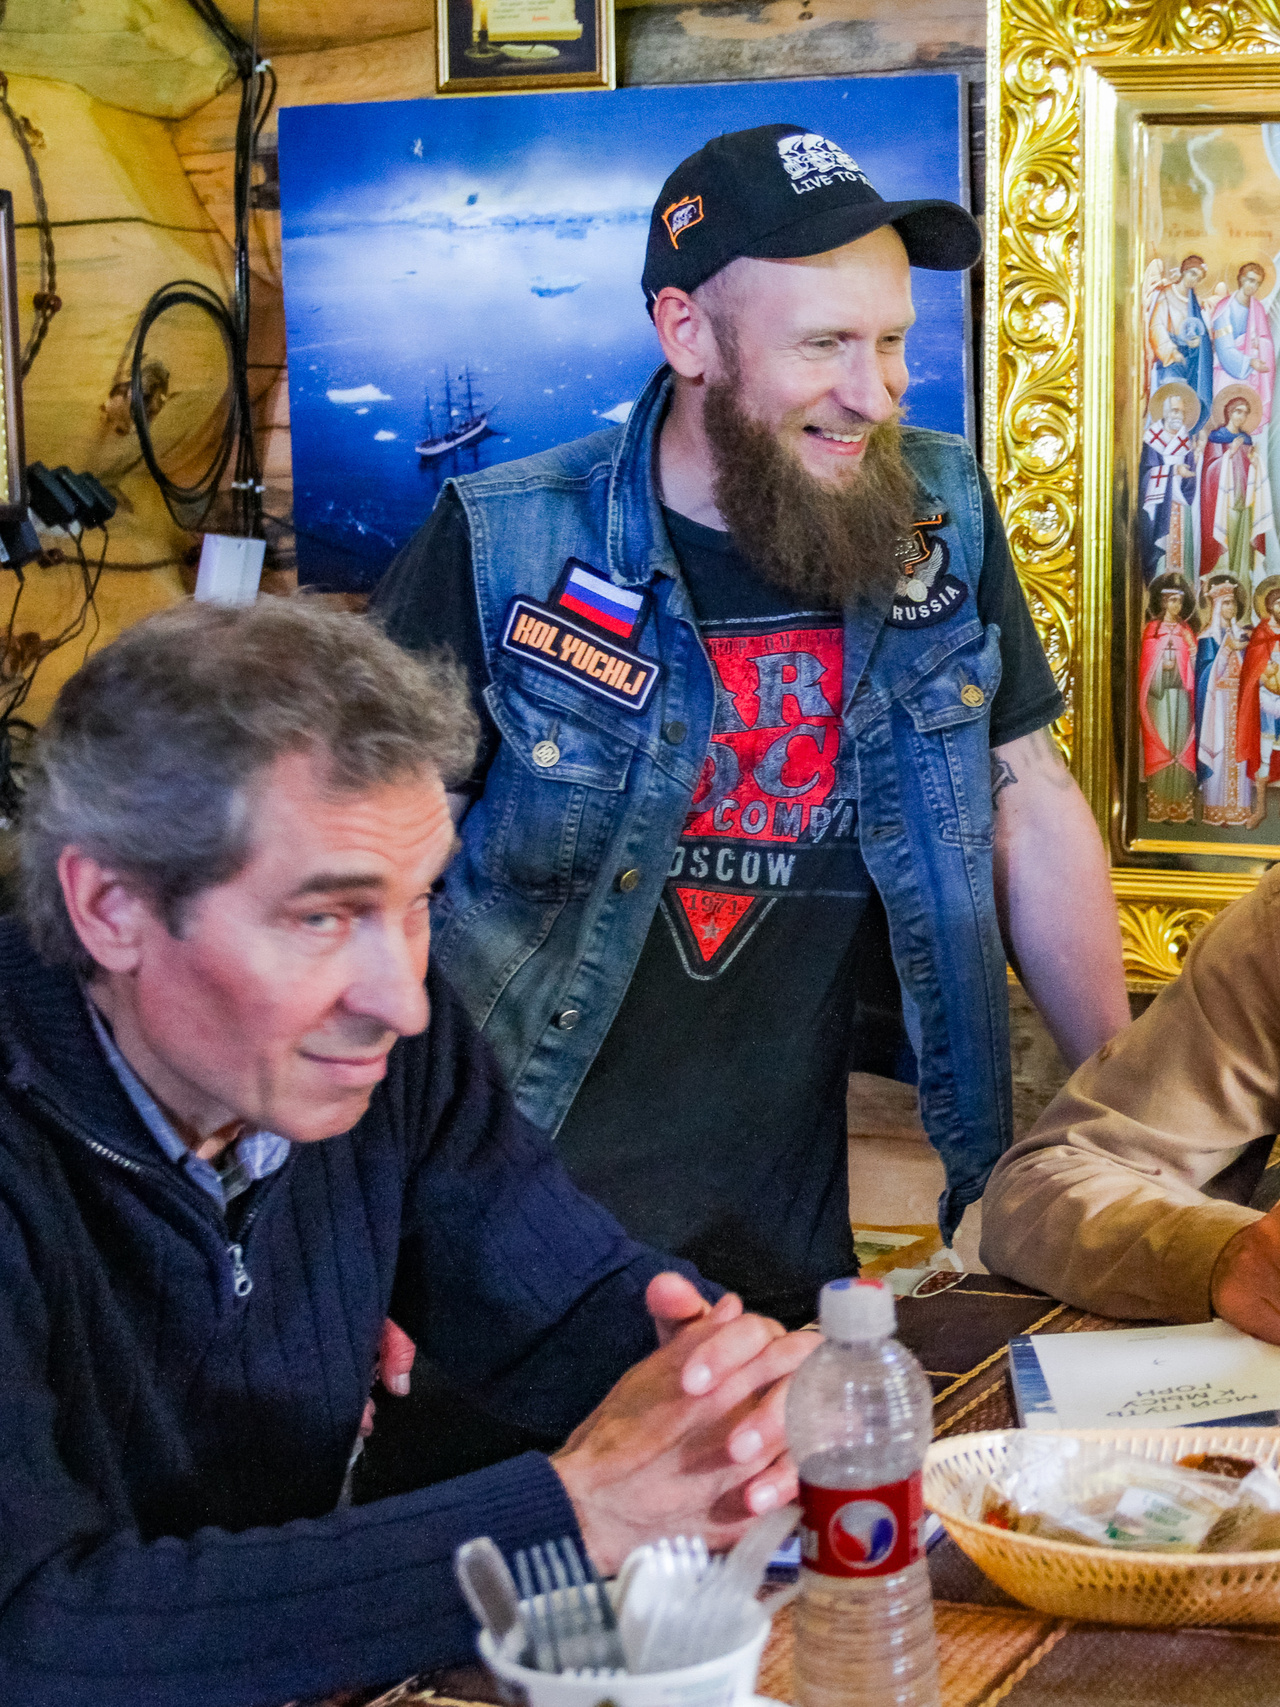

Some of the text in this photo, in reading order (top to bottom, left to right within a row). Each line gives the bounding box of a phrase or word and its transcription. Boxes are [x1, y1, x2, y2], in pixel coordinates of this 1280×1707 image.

[791, 174, 833, 195] LIVE
[833, 171, 858, 183] TO
[893, 585, 960, 621] RUSSIA
[512, 613, 647, 696] KOLYUCHIJ
[711, 631, 843, 656] TOP QUALIT
[713, 798, 859, 844] COMPA
[667, 846, 797, 887] OSCOW
[687, 893, 741, 917] 1971
[1122, 1388, 1236, 1409] К МЫСУ
[1135, 1382, 1212, 1398] ГОРН
[1106, 1403, 1182, 1418] ПУТЬ
